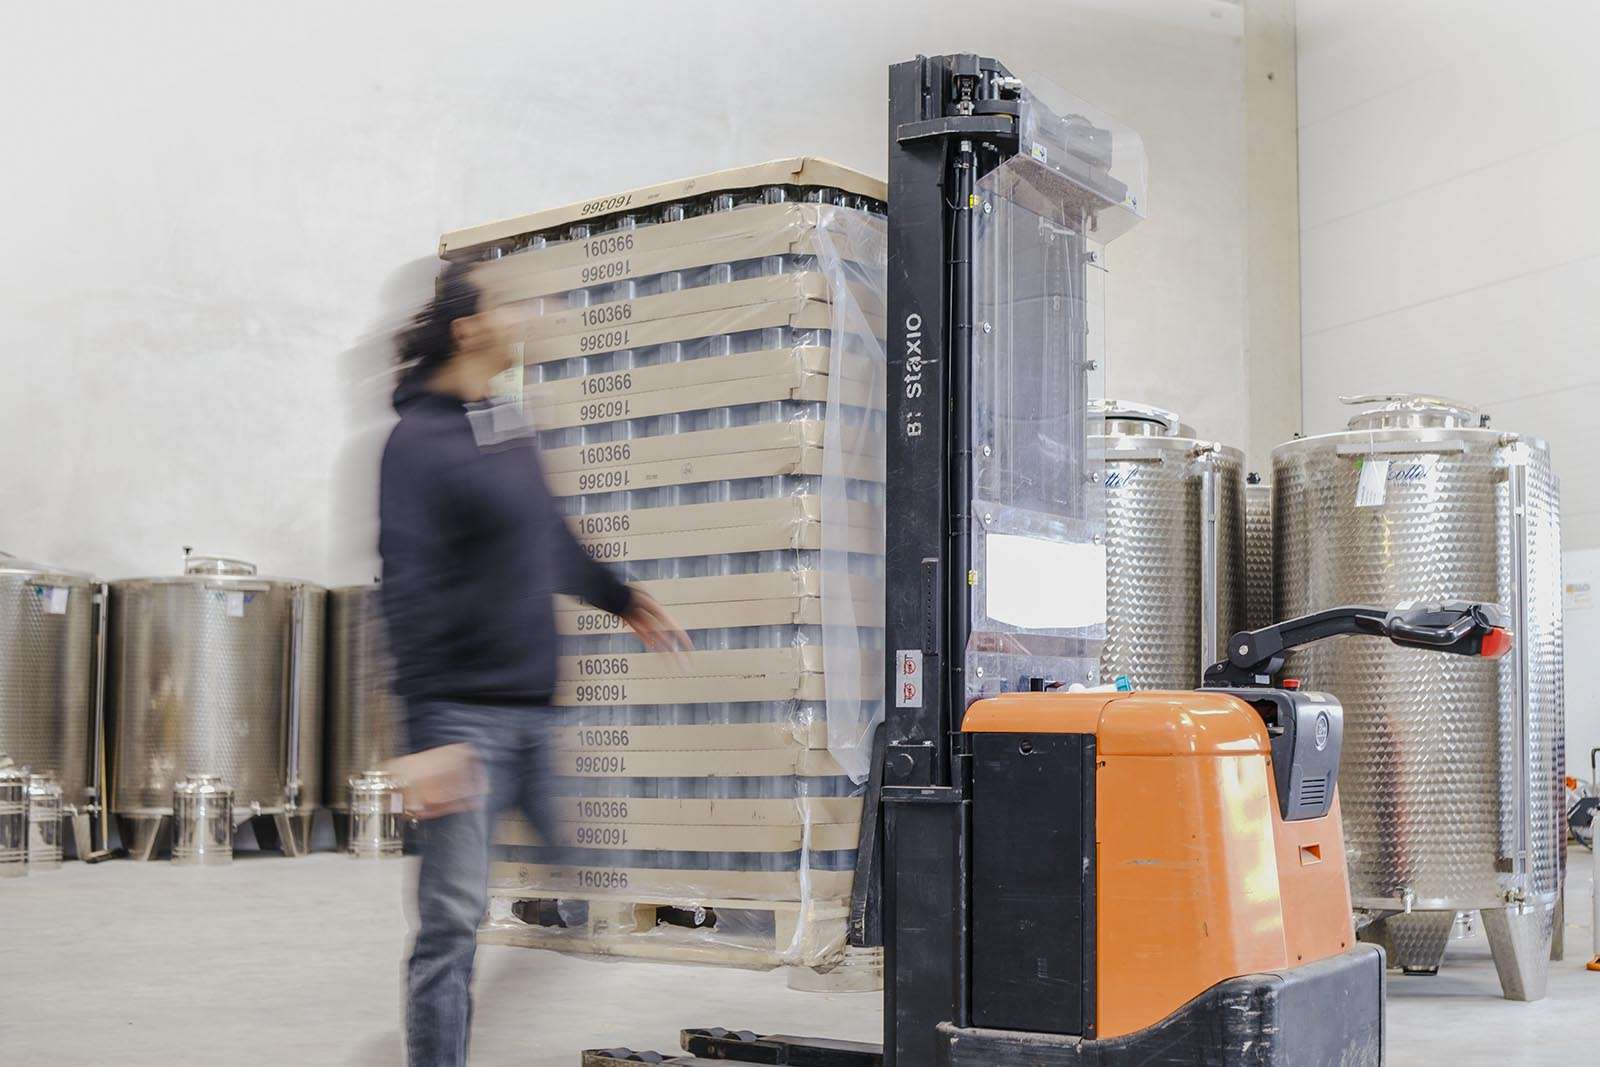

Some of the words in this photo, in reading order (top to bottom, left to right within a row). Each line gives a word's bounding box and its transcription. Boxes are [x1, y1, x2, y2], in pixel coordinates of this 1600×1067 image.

[581, 194, 632, 216] 160366
[583, 234, 634, 258] 160366
[581, 260, 631, 283] 160366
[581, 304, 632, 326] 160366
[580, 330, 631, 352] 160366
[581, 373, 632, 395] 160366
[580, 399, 631, 420] 160366
[579, 444, 631, 465] 160366
[579, 470, 630, 490] 160366
[578, 515, 630, 535] 160366
[577, 658, 629, 675] 160366
[576, 685, 628, 702] 160366
[577, 730, 630, 746] 160366
[576, 756, 627, 773] 160366
[577, 802, 628, 818] 160366
[576, 827, 629, 845] 160366
[577, 871, 629, 889] 160366
